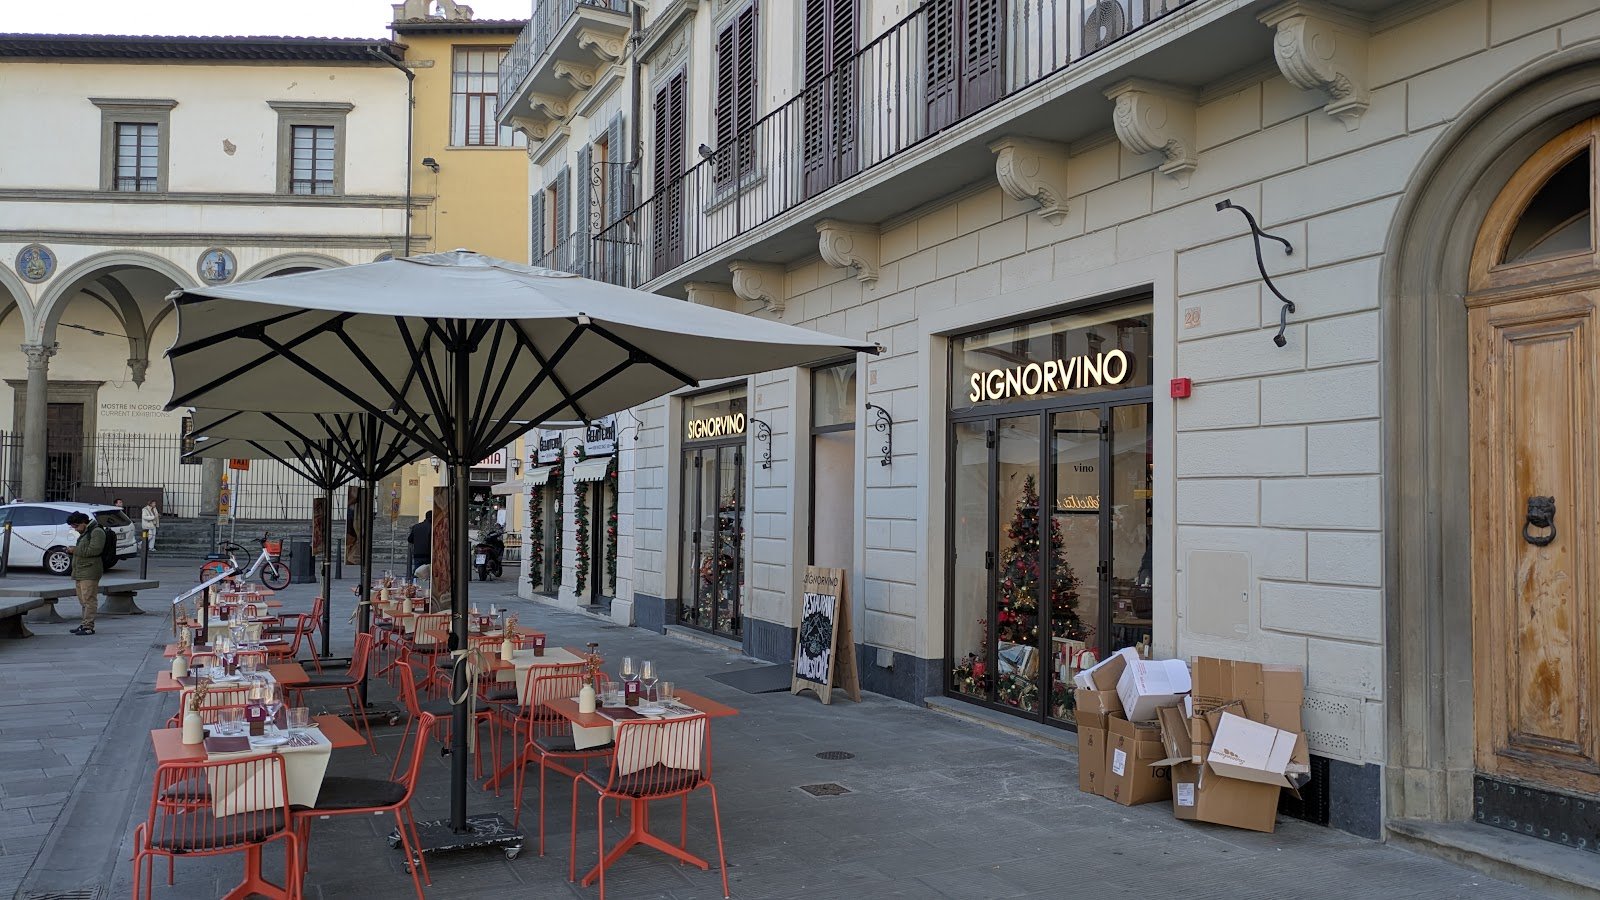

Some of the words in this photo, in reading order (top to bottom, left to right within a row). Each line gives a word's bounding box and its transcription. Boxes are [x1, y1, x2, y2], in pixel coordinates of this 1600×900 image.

[1184, 310, 1201, 325] 20
[969, 348, 1129, 403] SIGNORVINO
[688, 412, 745, 439] SIGNORVINO
[479, 452, 501, 465] RIA
[1073, 462, 1095, 473] vino
[803, 574, 839, 588] SIGNORVINO
[801, 592, 836, 625] RESTAURANT
